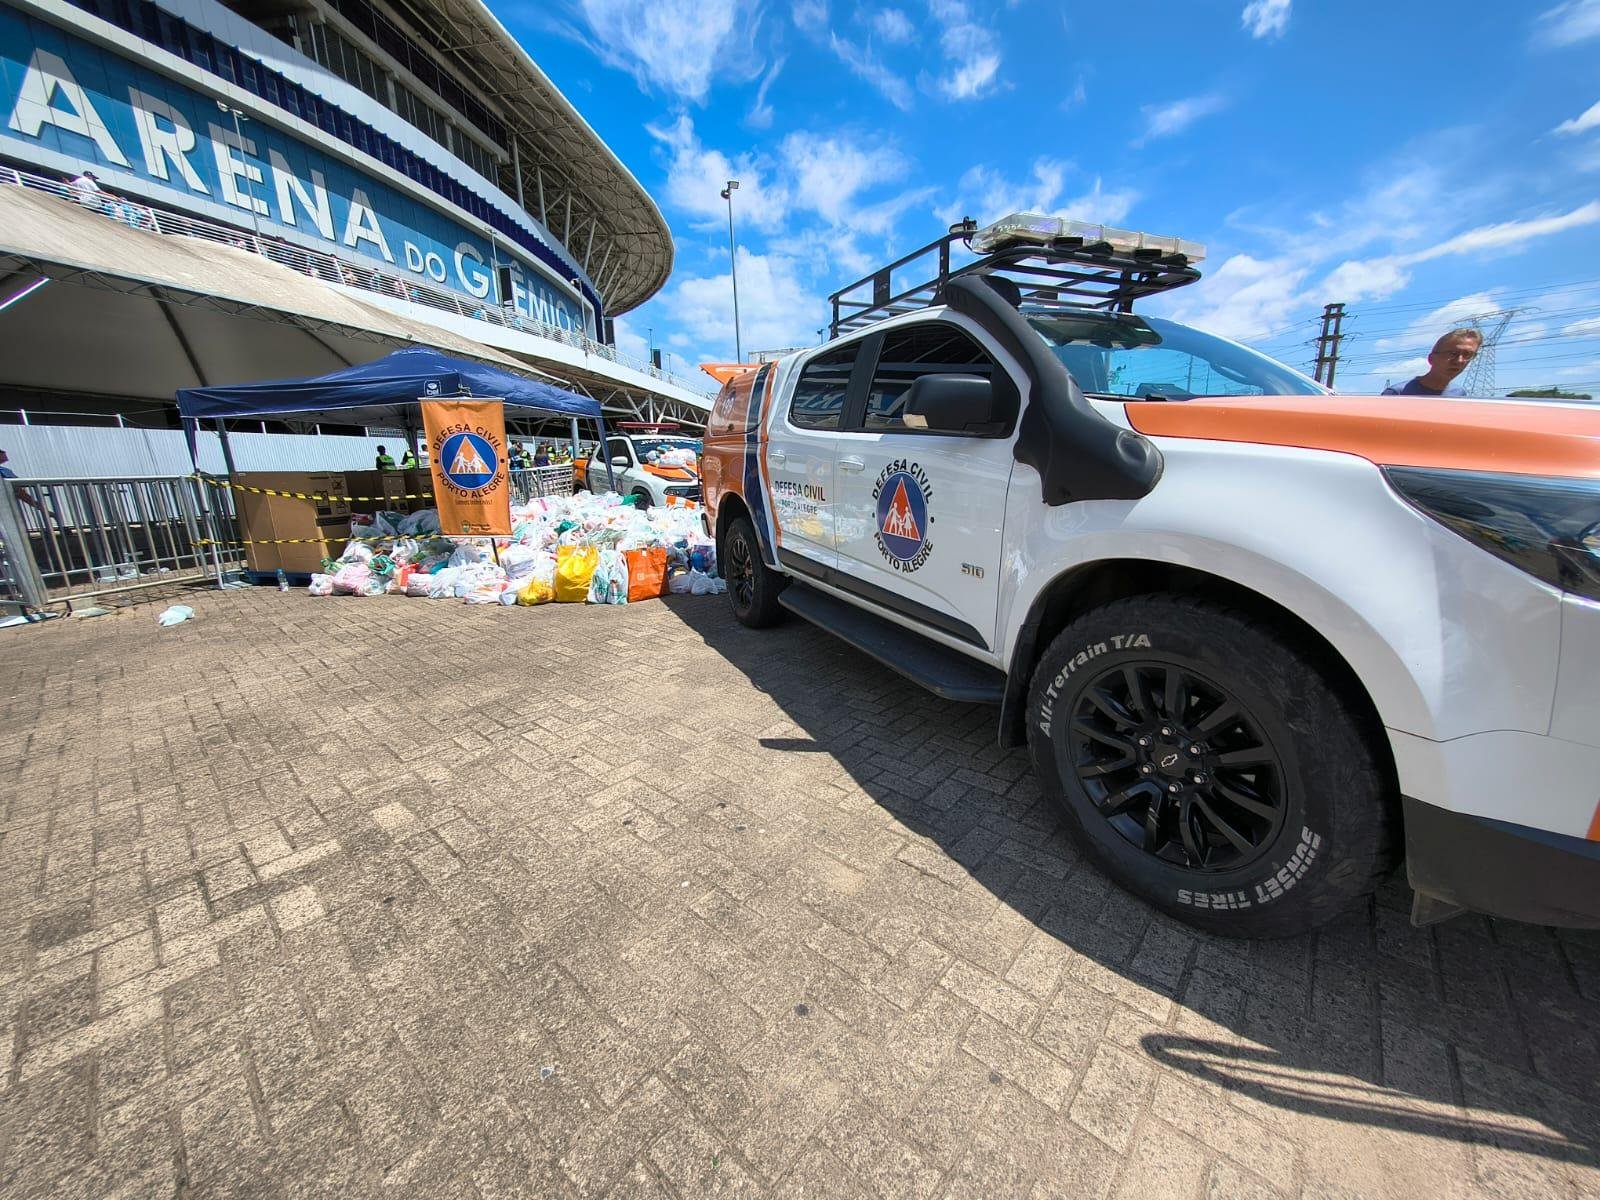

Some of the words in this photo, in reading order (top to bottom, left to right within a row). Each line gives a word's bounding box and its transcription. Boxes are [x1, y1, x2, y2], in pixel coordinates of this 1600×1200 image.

[8, 48, 394, 263] ARENA
[404, 240, 447, 283] DO
[433, 423, 471, 451] DEFESA
[476, 426, 502, 451] CIVIL
[437, 472, 468, 498] PORTO
[471, 471, 505, 499] ALEGRE
[775, 480, 803, 497] DEFESA
[804, 484, 826, 502] CIVIL
[872, 458, 907, 501] DEFESA
[910, 462, 934, 504] CIVIL
[874, 532, 900, 570] PORTO
[902, 538, 934, 573] ALEGRE
[1040, 642, 1107, 738] All-Terrain
[1110, 633, 1151, 649] T/A
[1255, 825, 1321, 904] SUNSET
[1177, 888, 1252, 910] TIRES
